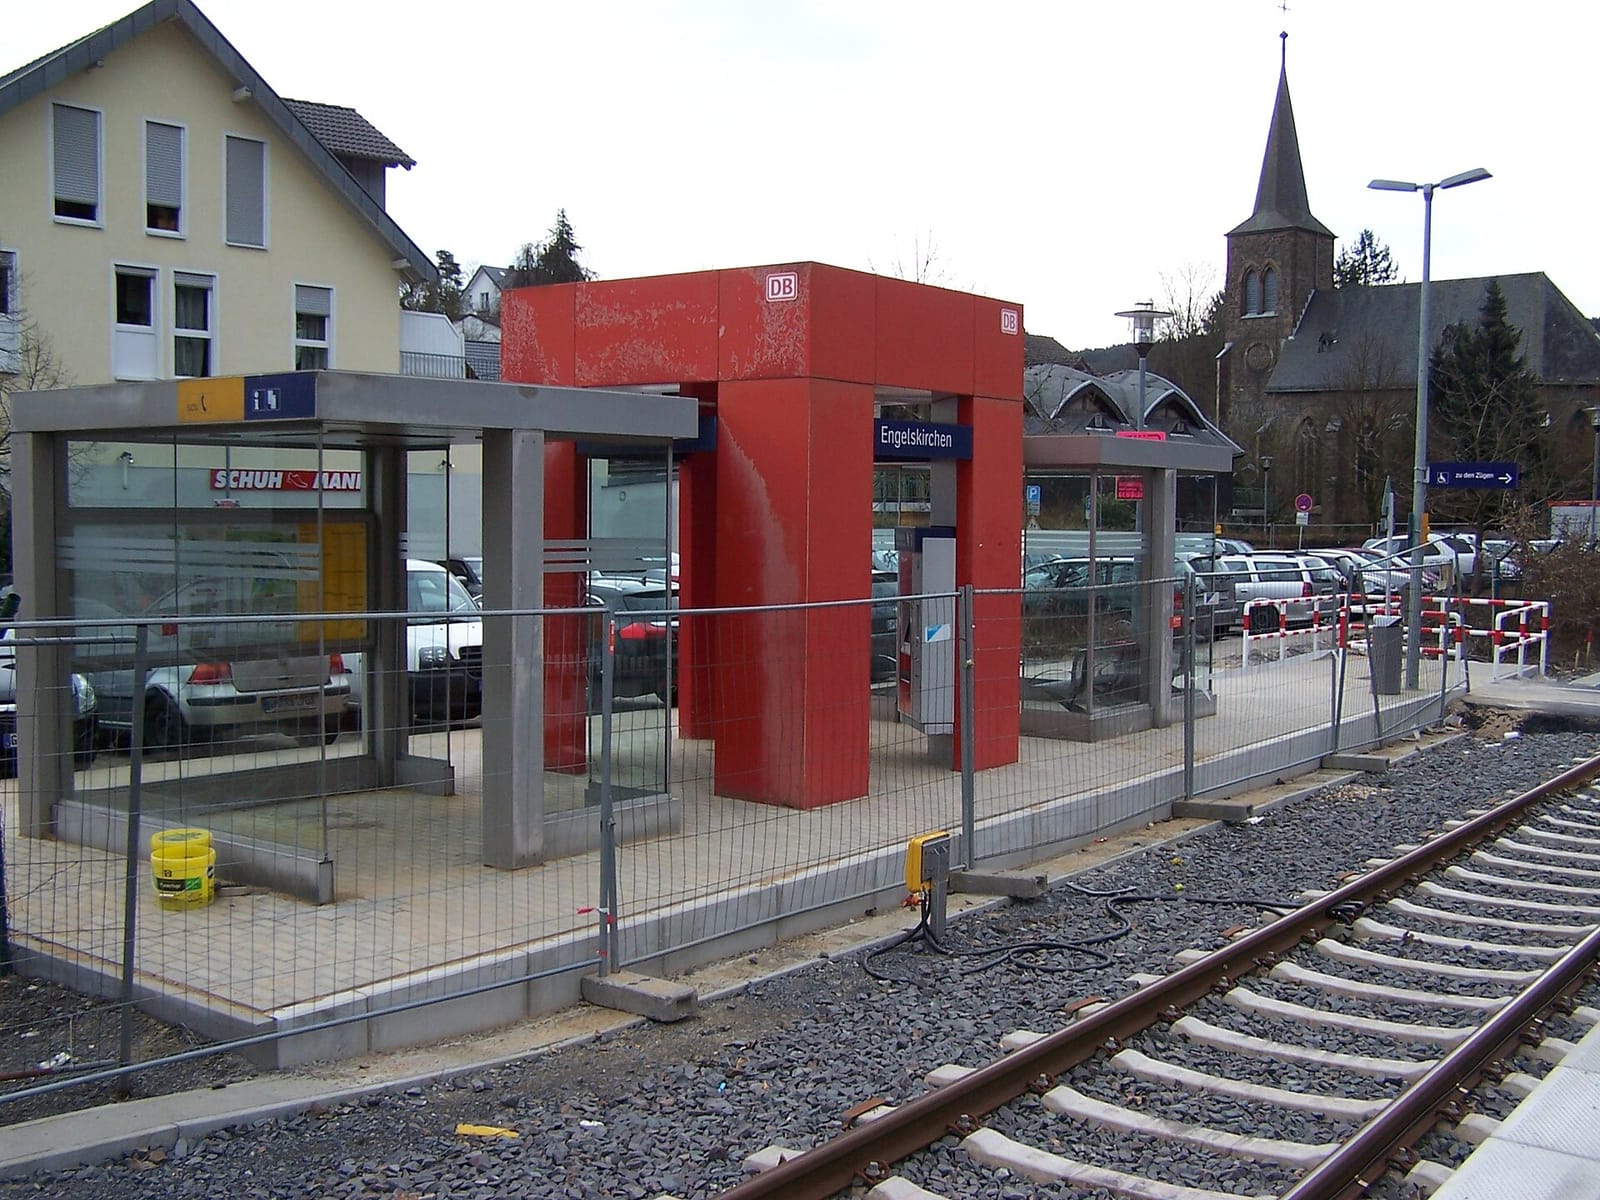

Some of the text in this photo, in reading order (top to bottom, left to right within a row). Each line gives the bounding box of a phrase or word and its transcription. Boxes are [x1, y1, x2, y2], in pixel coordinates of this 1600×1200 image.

[771, 278, 793, 296] DB
[1003, 313, 1016, 329] DB
[880, 425, 953, 449] Engelskirchen
[214, 471, 284, 489] SCHUH
[1463, 472, 1475, 480] den
[1475, 471, 1495, 480] Zügen
[1029, 487, 1037, 499] P
